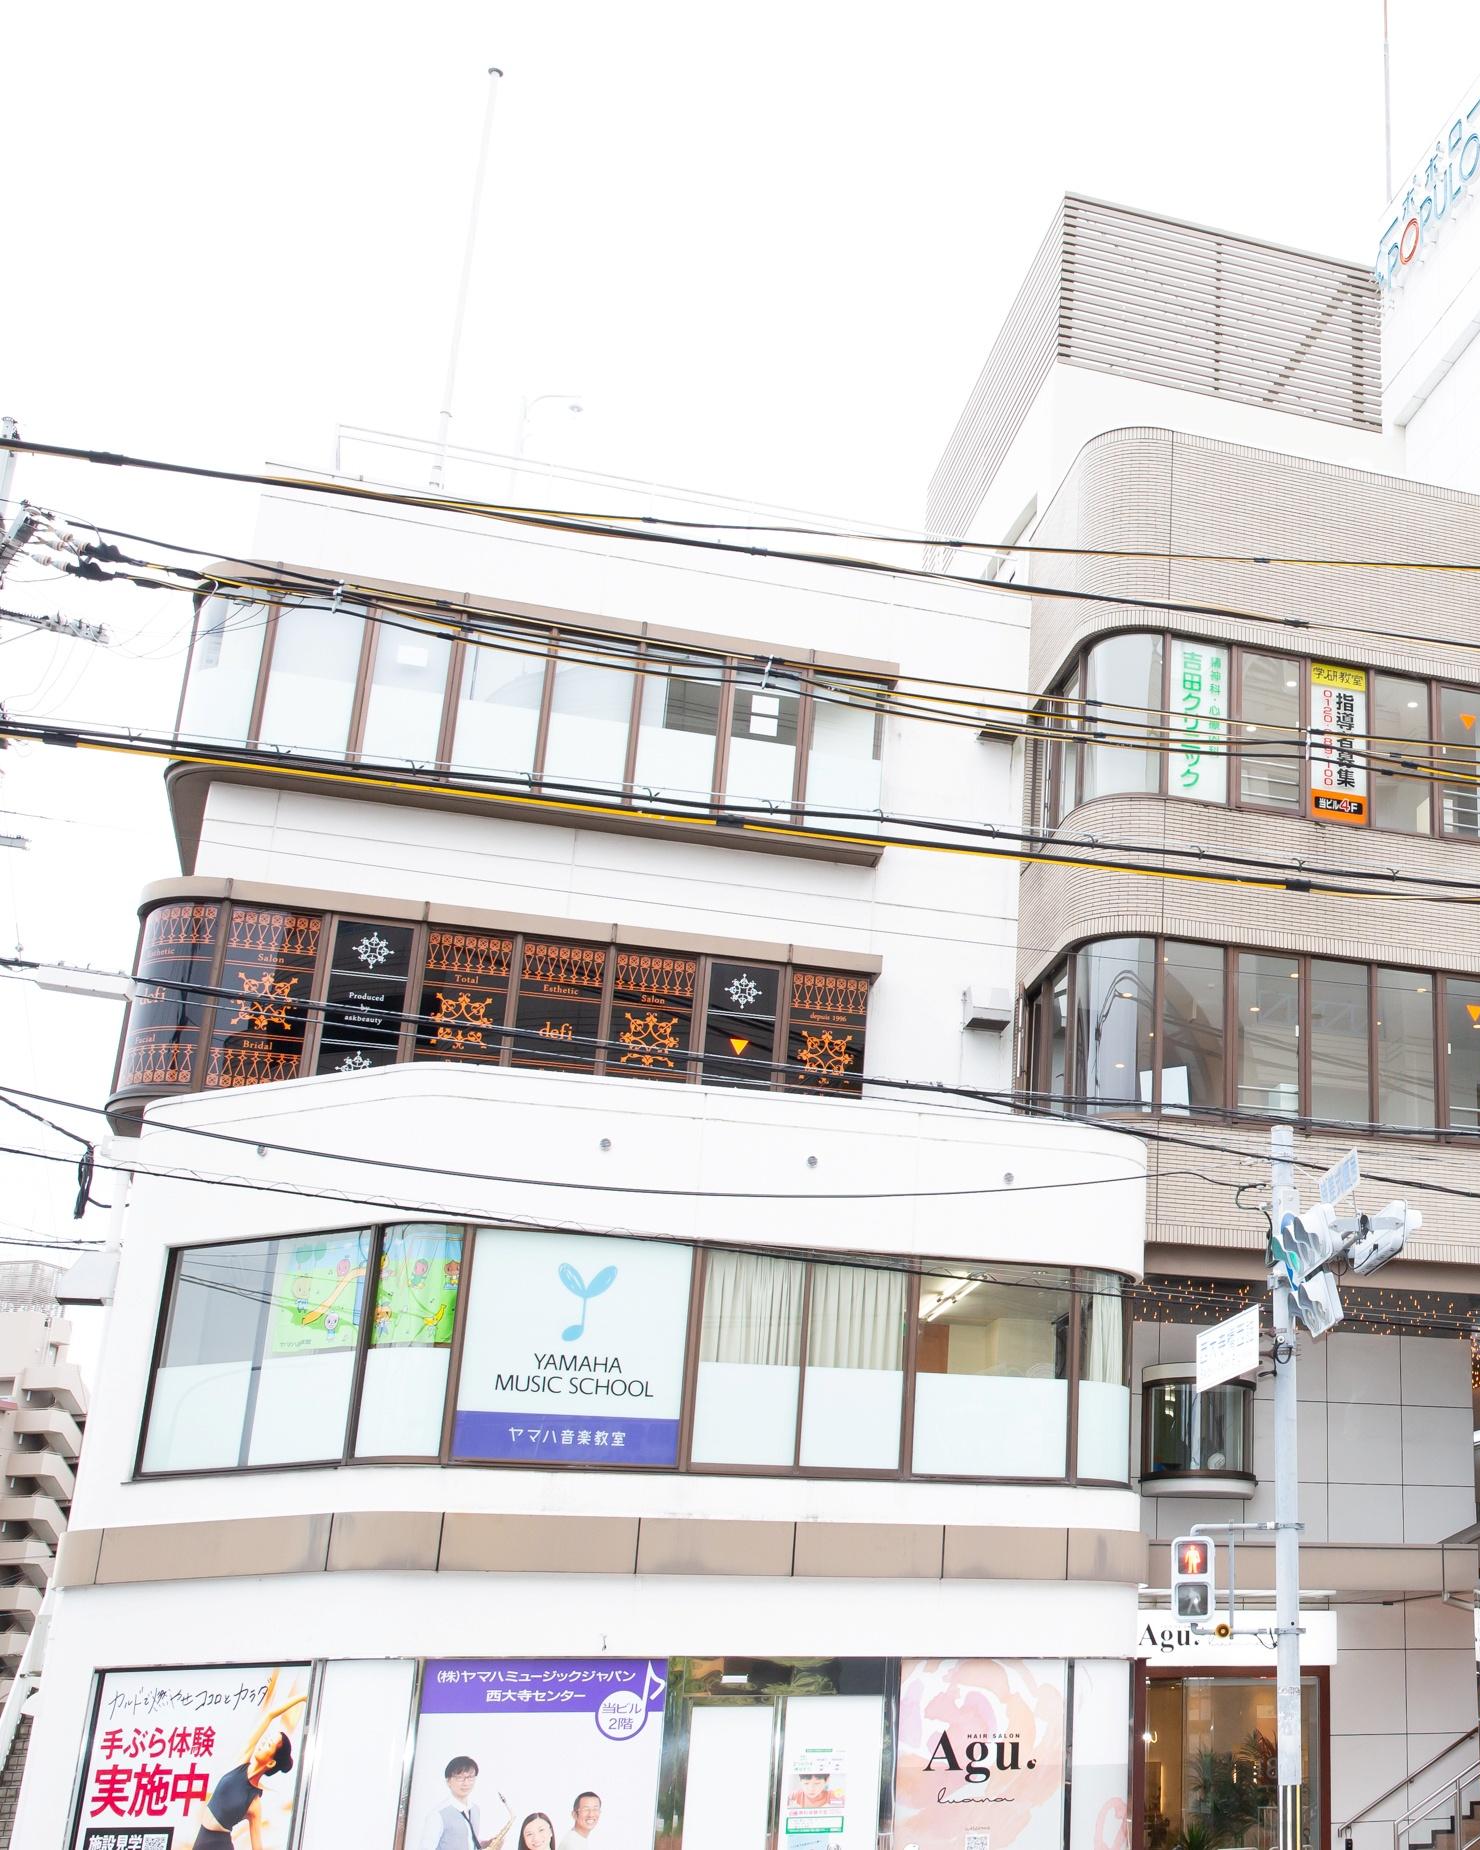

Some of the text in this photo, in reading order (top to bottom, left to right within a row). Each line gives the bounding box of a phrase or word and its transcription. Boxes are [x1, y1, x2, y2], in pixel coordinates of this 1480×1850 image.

[1387, 132, 1480, 289] POPULO
[1312, 666, 1363, 687] 学研教室
[1318, 797, 1359, 814] 当ビル4F
[257, 952, 285, 965] Salon
[454, 973, 479, 985] Total
[348, 991, 385, 1003] Produced
[543, 983, 579, 996] Esthetic
[640, 993, 666, 1006] Salon
[344, 1014, 383, 1026] askbeauty
[832, 1014, 848, 1024] 1996
[538, 1021, 573, 1042] defi
[242, 1039, 273, 1052] Bridal
[534, 1352, 622, 1374] YAMAHA
[494, 1373, 655, 1398] MUSIC SCHOOL
[508, 1425, 626, 1448] ヤマハ音楽教室
[1138, 1623, 1200, 1653] Agu.
[436, 1669, 636, 1684] (株)ヤマハミュージックジャパン
[485, 1689, 587, 1703] 西大寺センター
[602, 1702, 643, 1715] 当ビル
[608, 1717, 634, 1731] 2階
[100, 1725, 217, 1760] 手ぶら体験
[922, 1730, 1037, 1783] Agu.
[90, 1762, 210, 1818] 実施中
